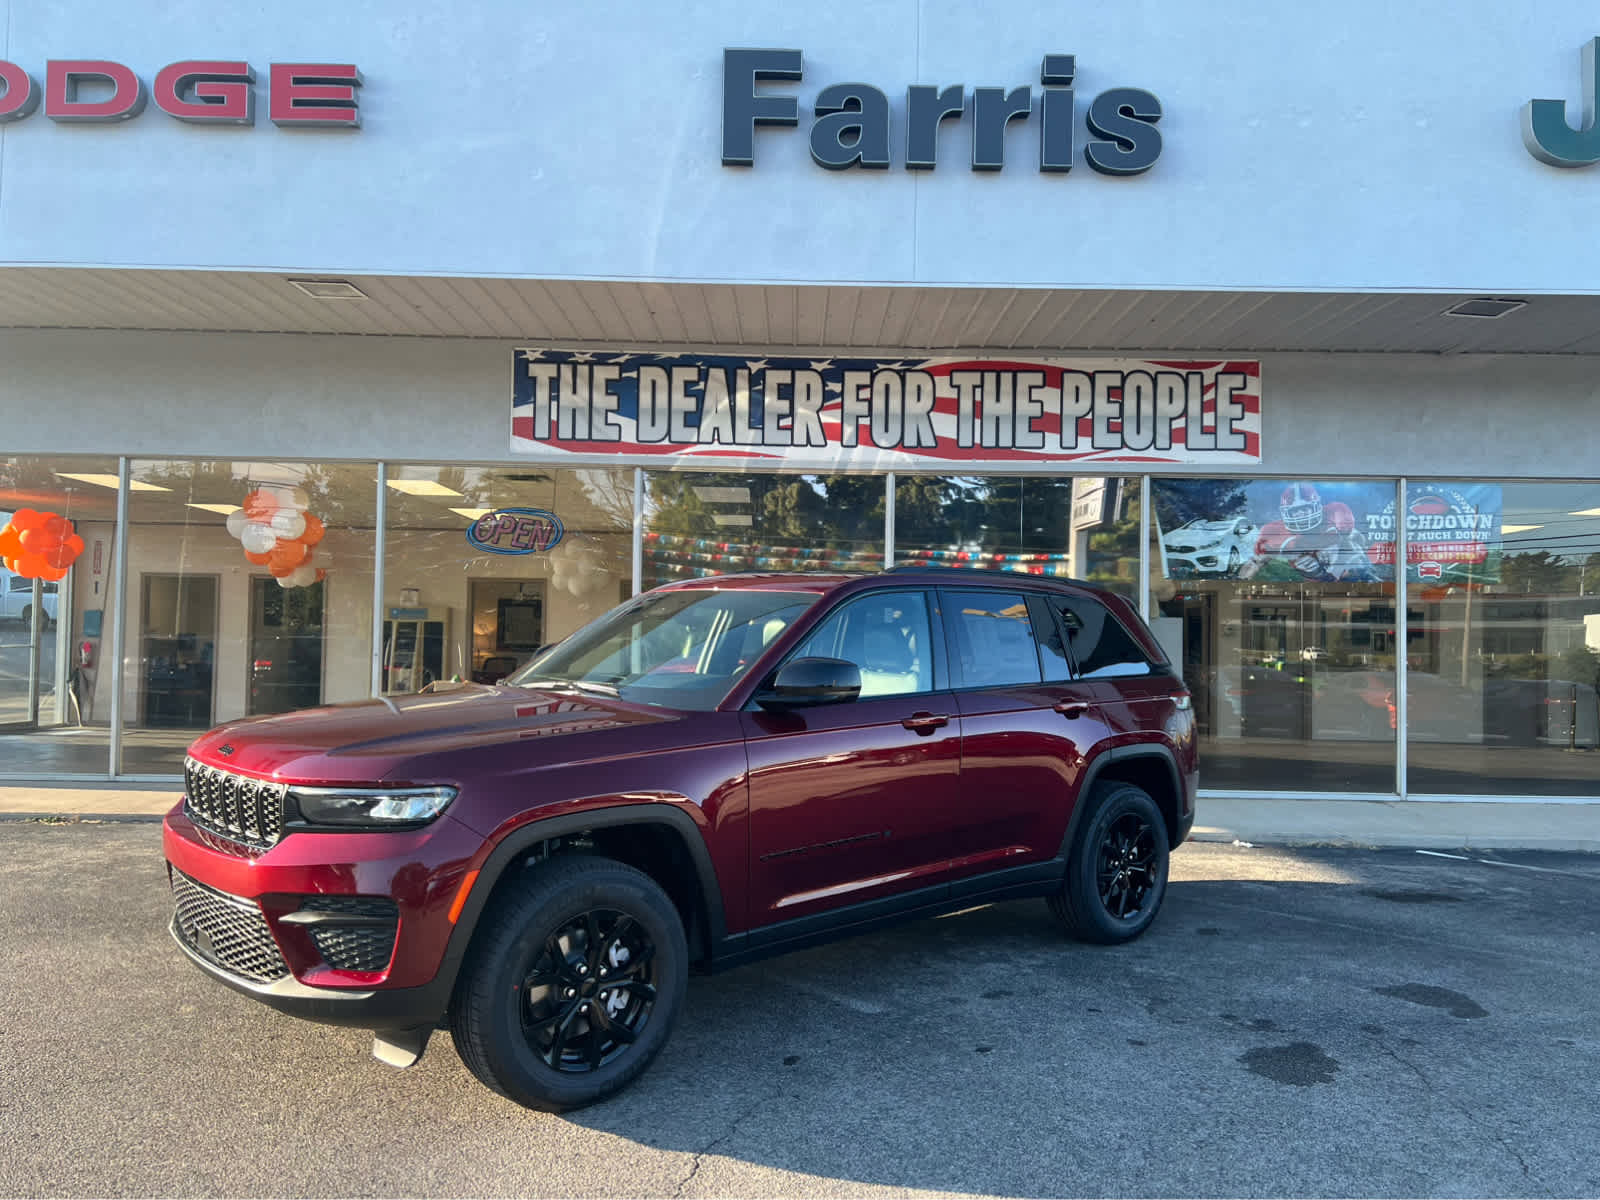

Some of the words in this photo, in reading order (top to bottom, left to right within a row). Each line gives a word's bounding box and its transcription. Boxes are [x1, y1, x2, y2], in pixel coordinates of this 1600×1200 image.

[722, 48, 1163, 176] Farris
[528, 362, 621, 442] THE
[636, 365, 827, 448] DEALER
[841, 368, 937, 450] FOR
[950, 370, 1046, 450] THE
[1060, 370, 1247, 451] PEOPLE
[475, 513, 553, 551] OPEN
[1366, 514, 1494, 530] TOCHDOWN
[1367, 531, 1388, 541] FOR
[1417, 531, 1451, 541] MUCH
